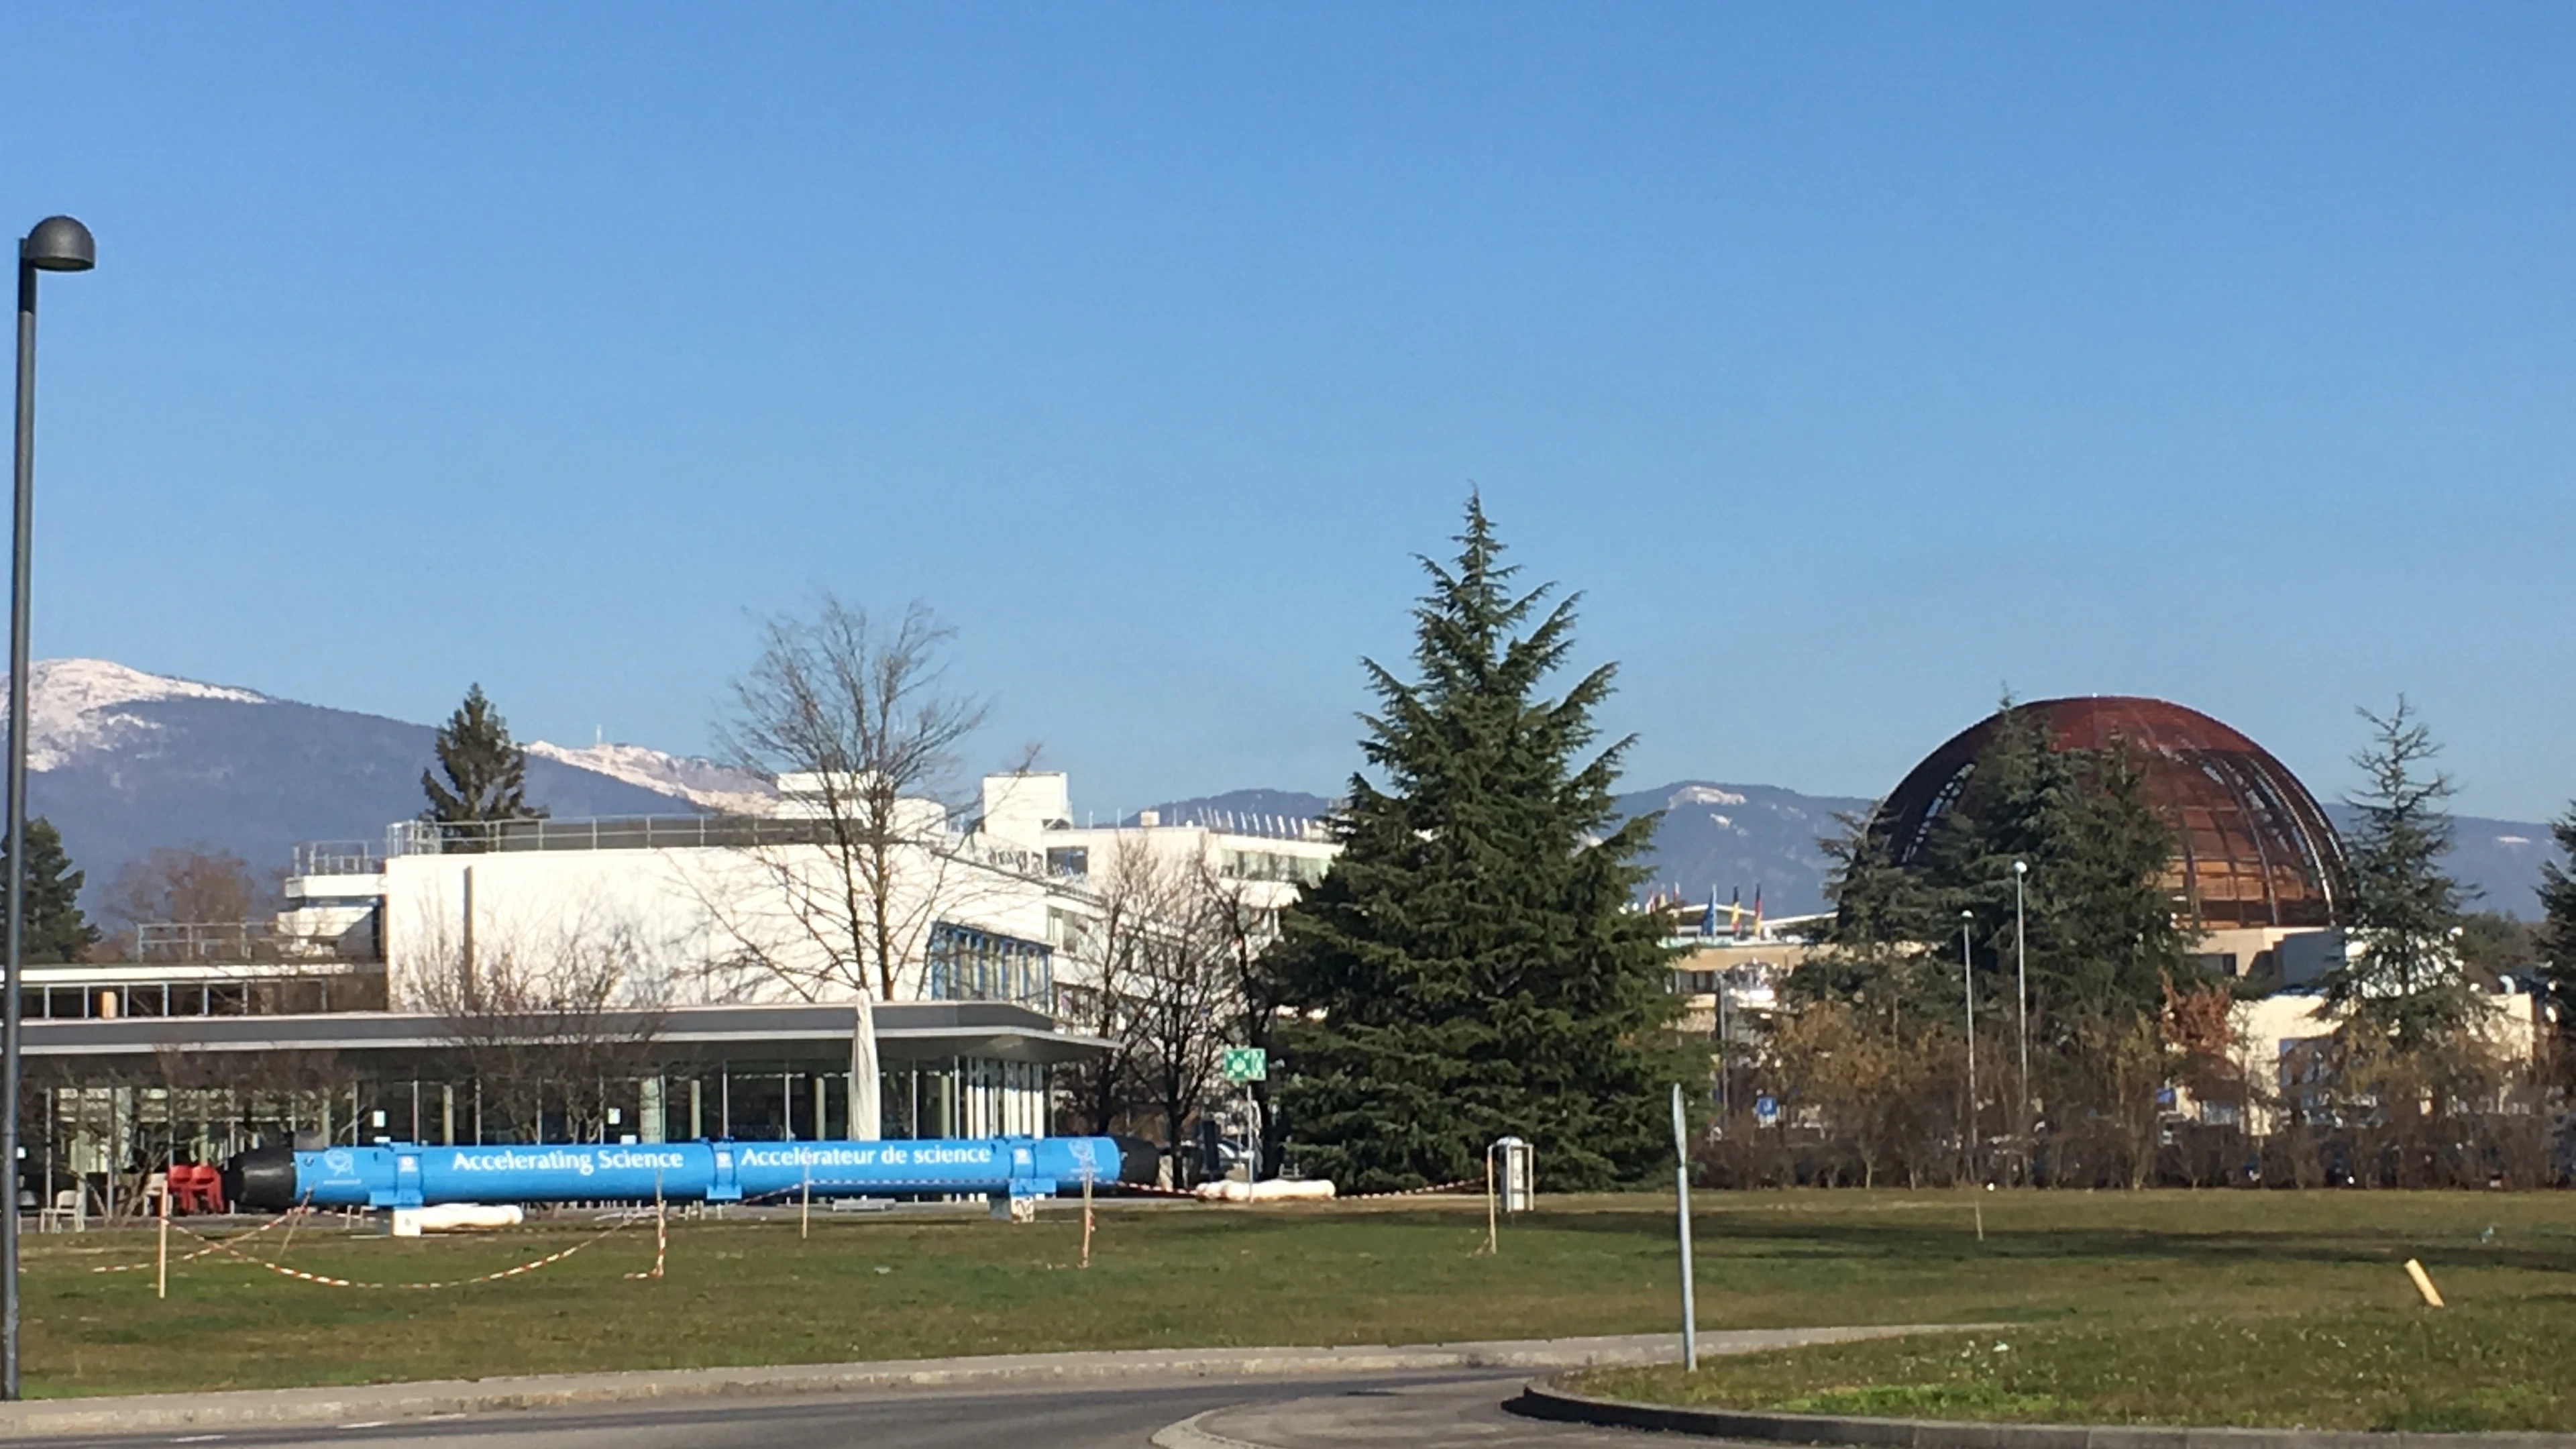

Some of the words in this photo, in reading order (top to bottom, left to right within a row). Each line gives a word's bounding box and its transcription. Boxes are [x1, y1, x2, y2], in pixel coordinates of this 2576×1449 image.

[451, 1150, 595, 1176] Accelerating
[598, 1149, 684, 1171] Science
[880, 1144, 908, 1165] de
[912, 1144, 992, 1164] science
